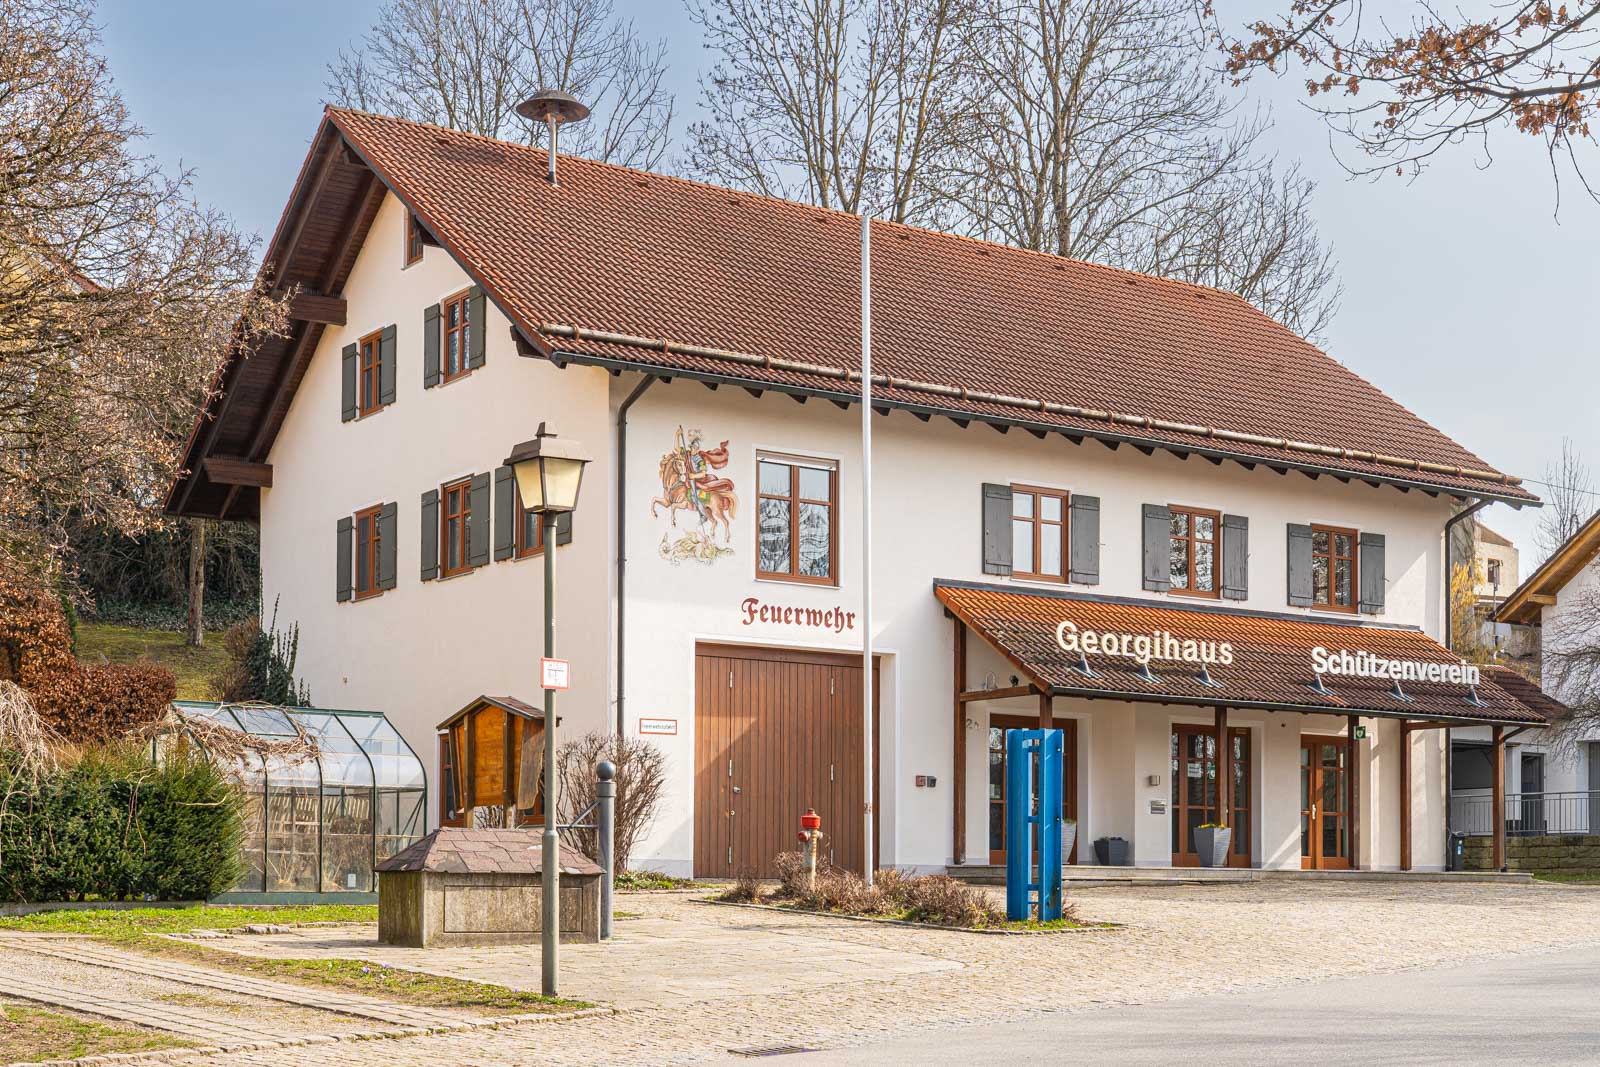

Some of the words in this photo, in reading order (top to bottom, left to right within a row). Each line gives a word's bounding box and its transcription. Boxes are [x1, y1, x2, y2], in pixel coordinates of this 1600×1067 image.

[741, 597, 856, 634] Feuerwehr
[1055, 620, 1233, 665] Georgihaus
[1311, 646, 1480, 685] Schützenverein
